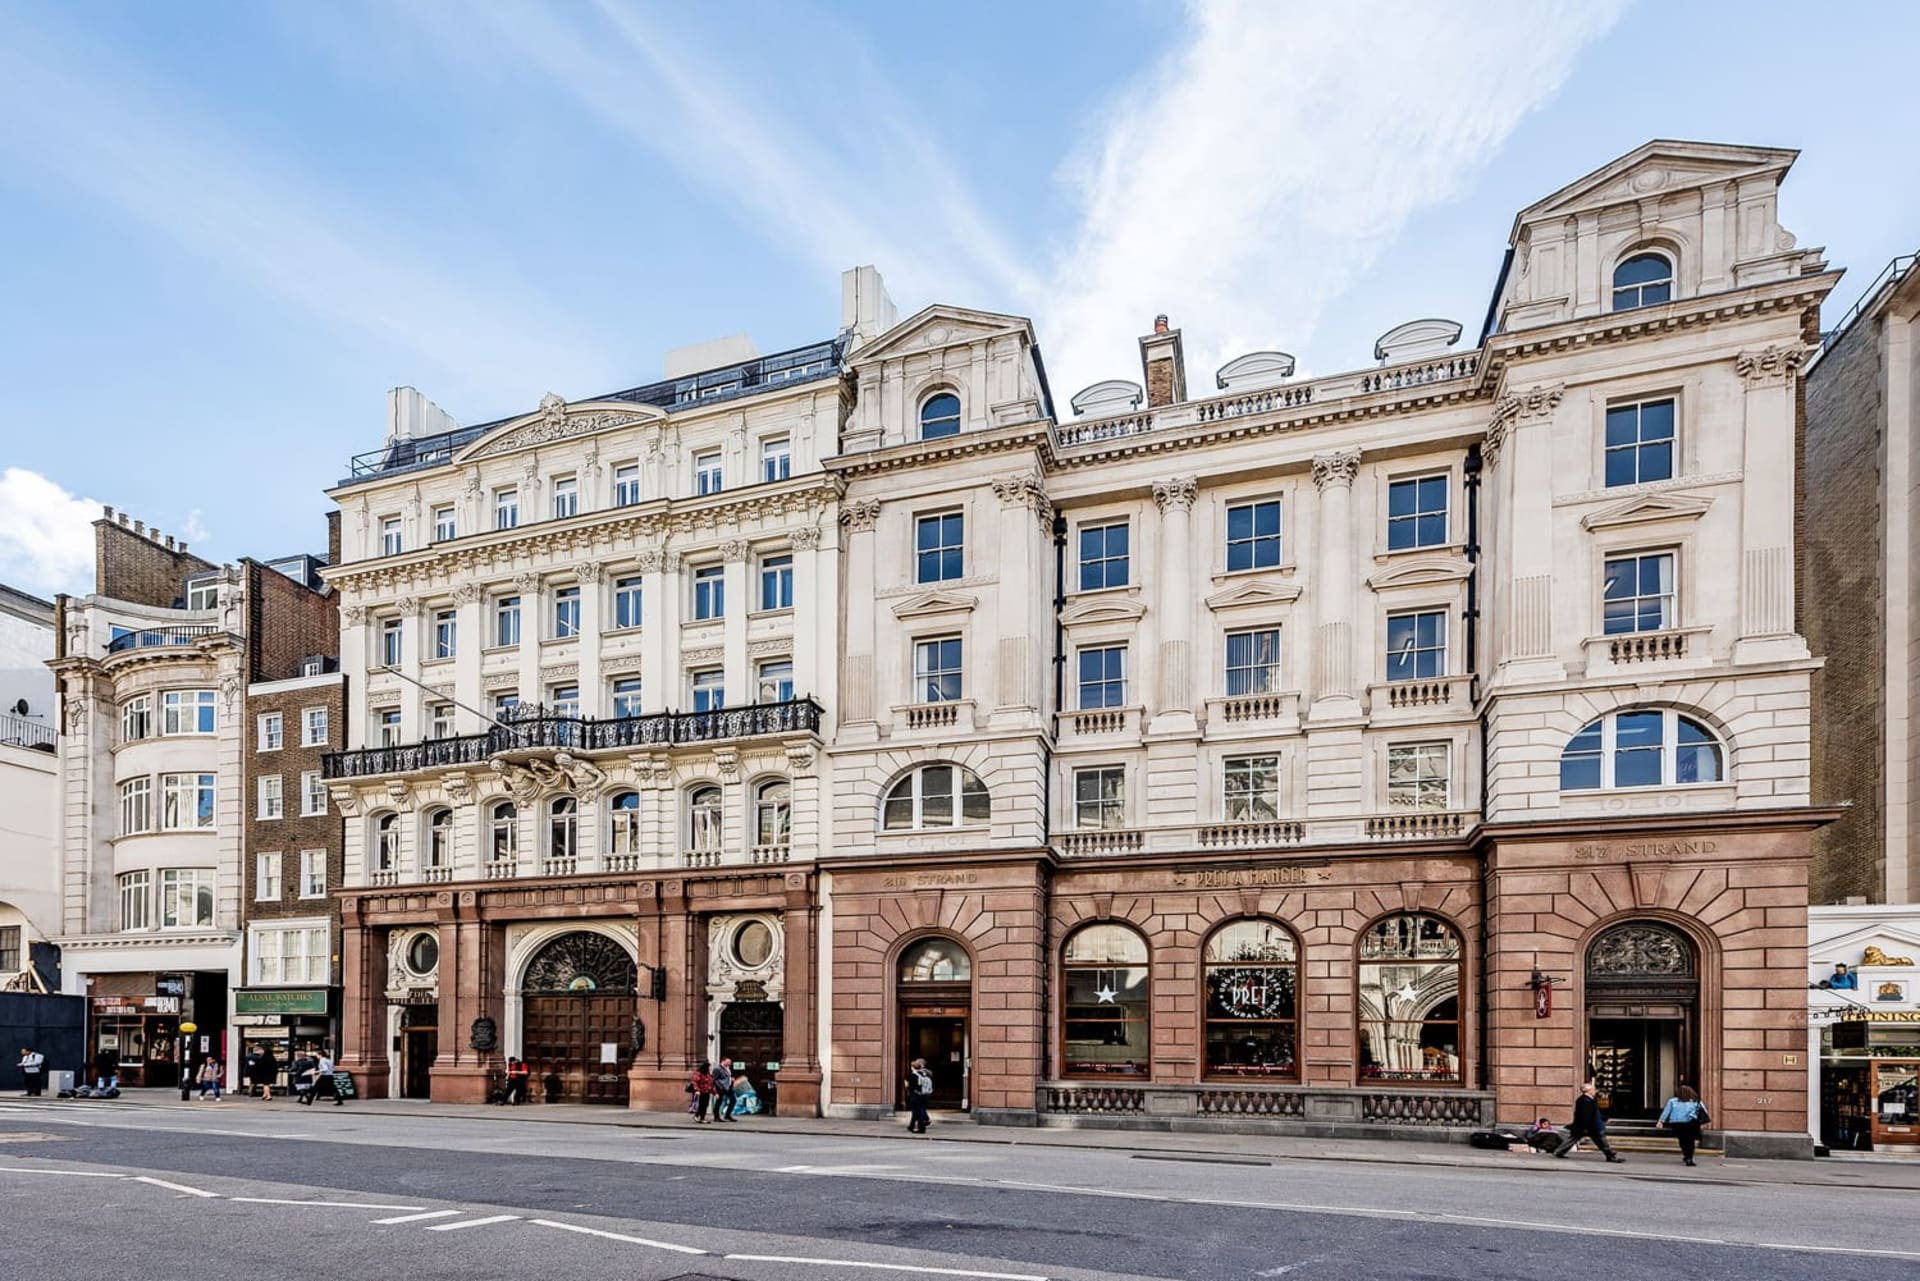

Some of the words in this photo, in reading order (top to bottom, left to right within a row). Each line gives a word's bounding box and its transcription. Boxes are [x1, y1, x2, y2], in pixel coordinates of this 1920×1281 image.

[1575, 845, 1609, 859] 217
[1625, 840, 1717, 857] STRAND
[917, 873, 978, 886] STRAND
[1196, 869, 1229, 886] PRET
[1234, 870, 1245, 885] A
[1250, 866, 1307, 885] MANGER
[1232, 986, 1269, 1005] PRET
[1221, 1001, 1259, 1018] NATURAL
